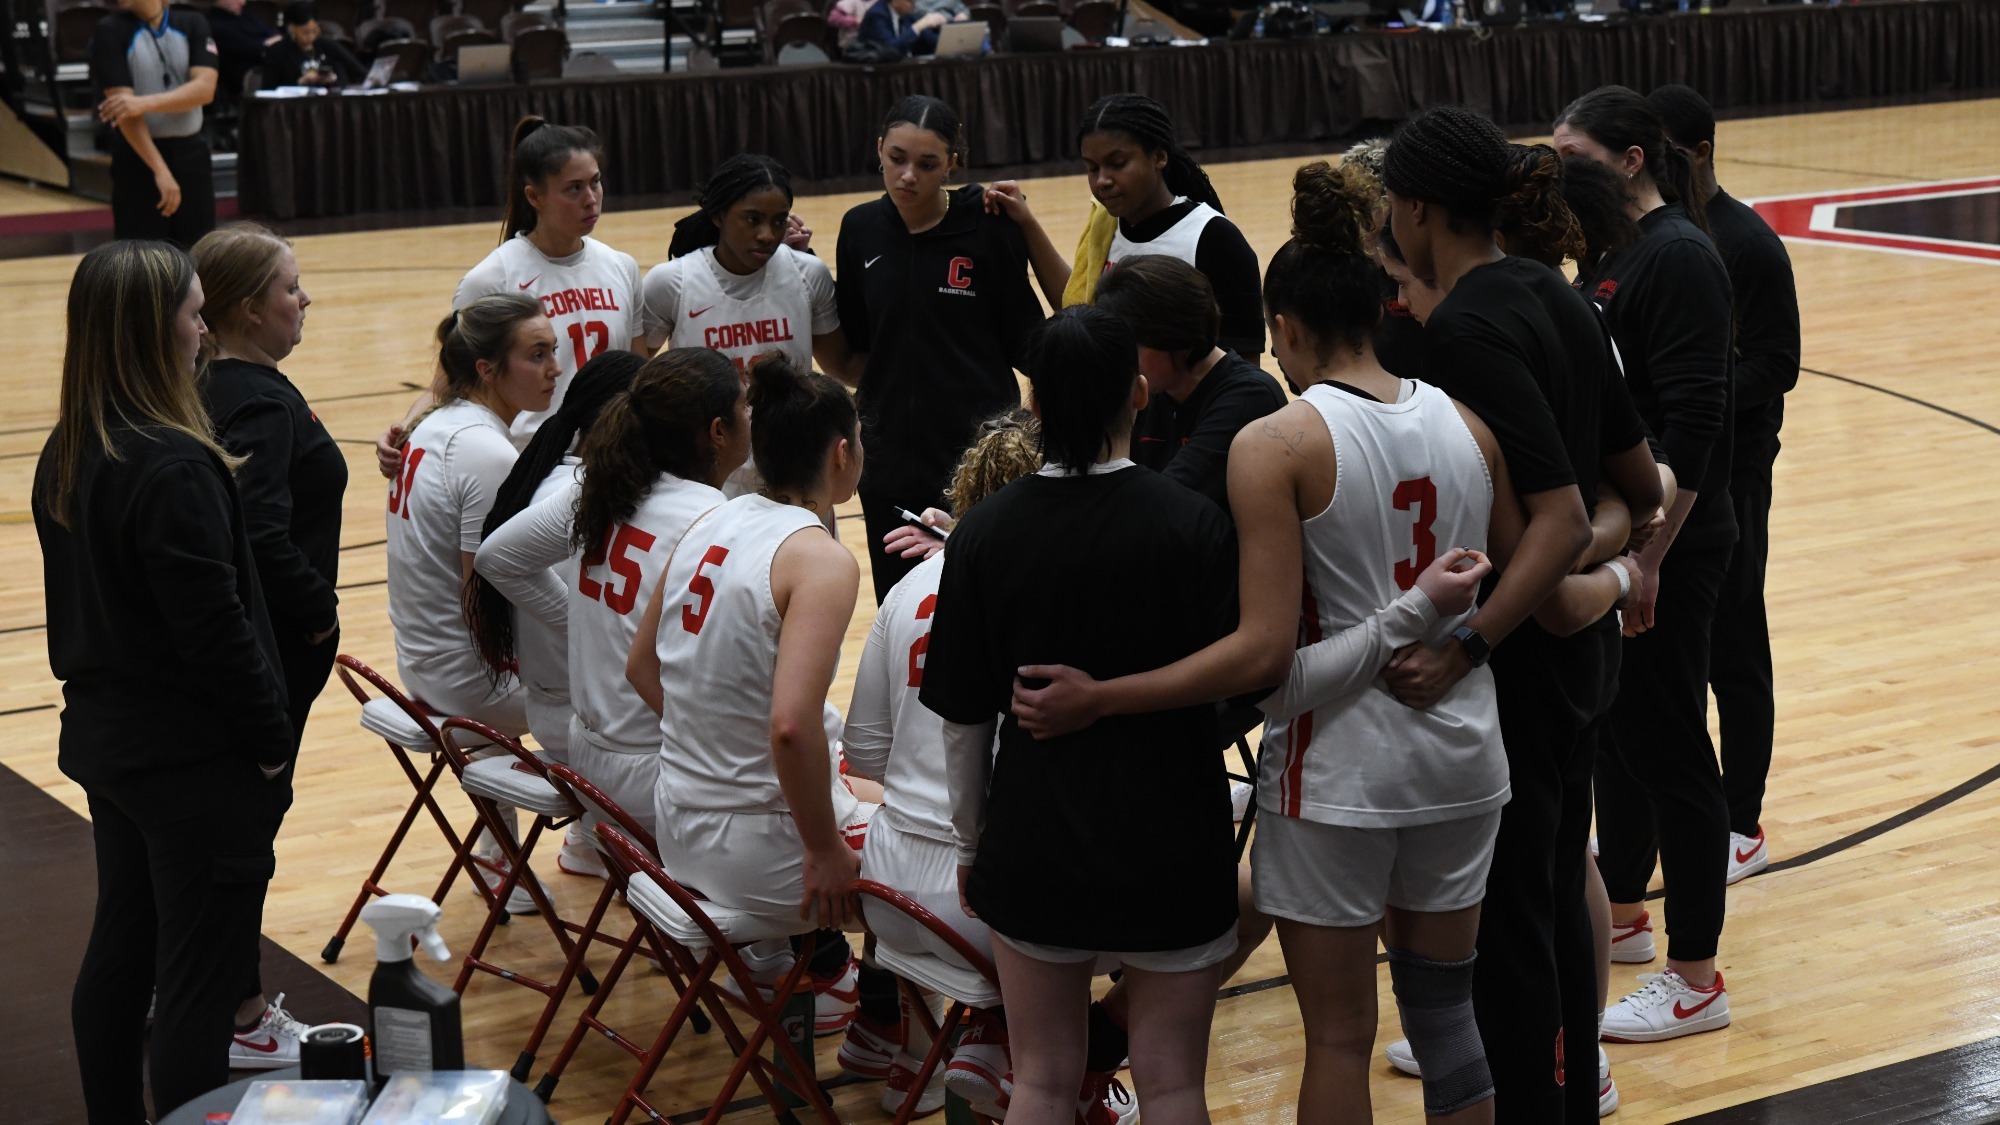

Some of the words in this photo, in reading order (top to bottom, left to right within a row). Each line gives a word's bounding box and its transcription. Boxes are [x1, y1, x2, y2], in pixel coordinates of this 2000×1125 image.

[938, 286, 977, 297] BASKETBALL
[948, 256, 974, 289] C
[541, 287, 620, 319] CORNELL
[704, 317, 794, 350] CORNELL
[389, 441, 426, 520] 31
[1392, 475, 1437, 591] 3
[578, 522, 657, 616] 25
[682, 545, 730, 636] 5
